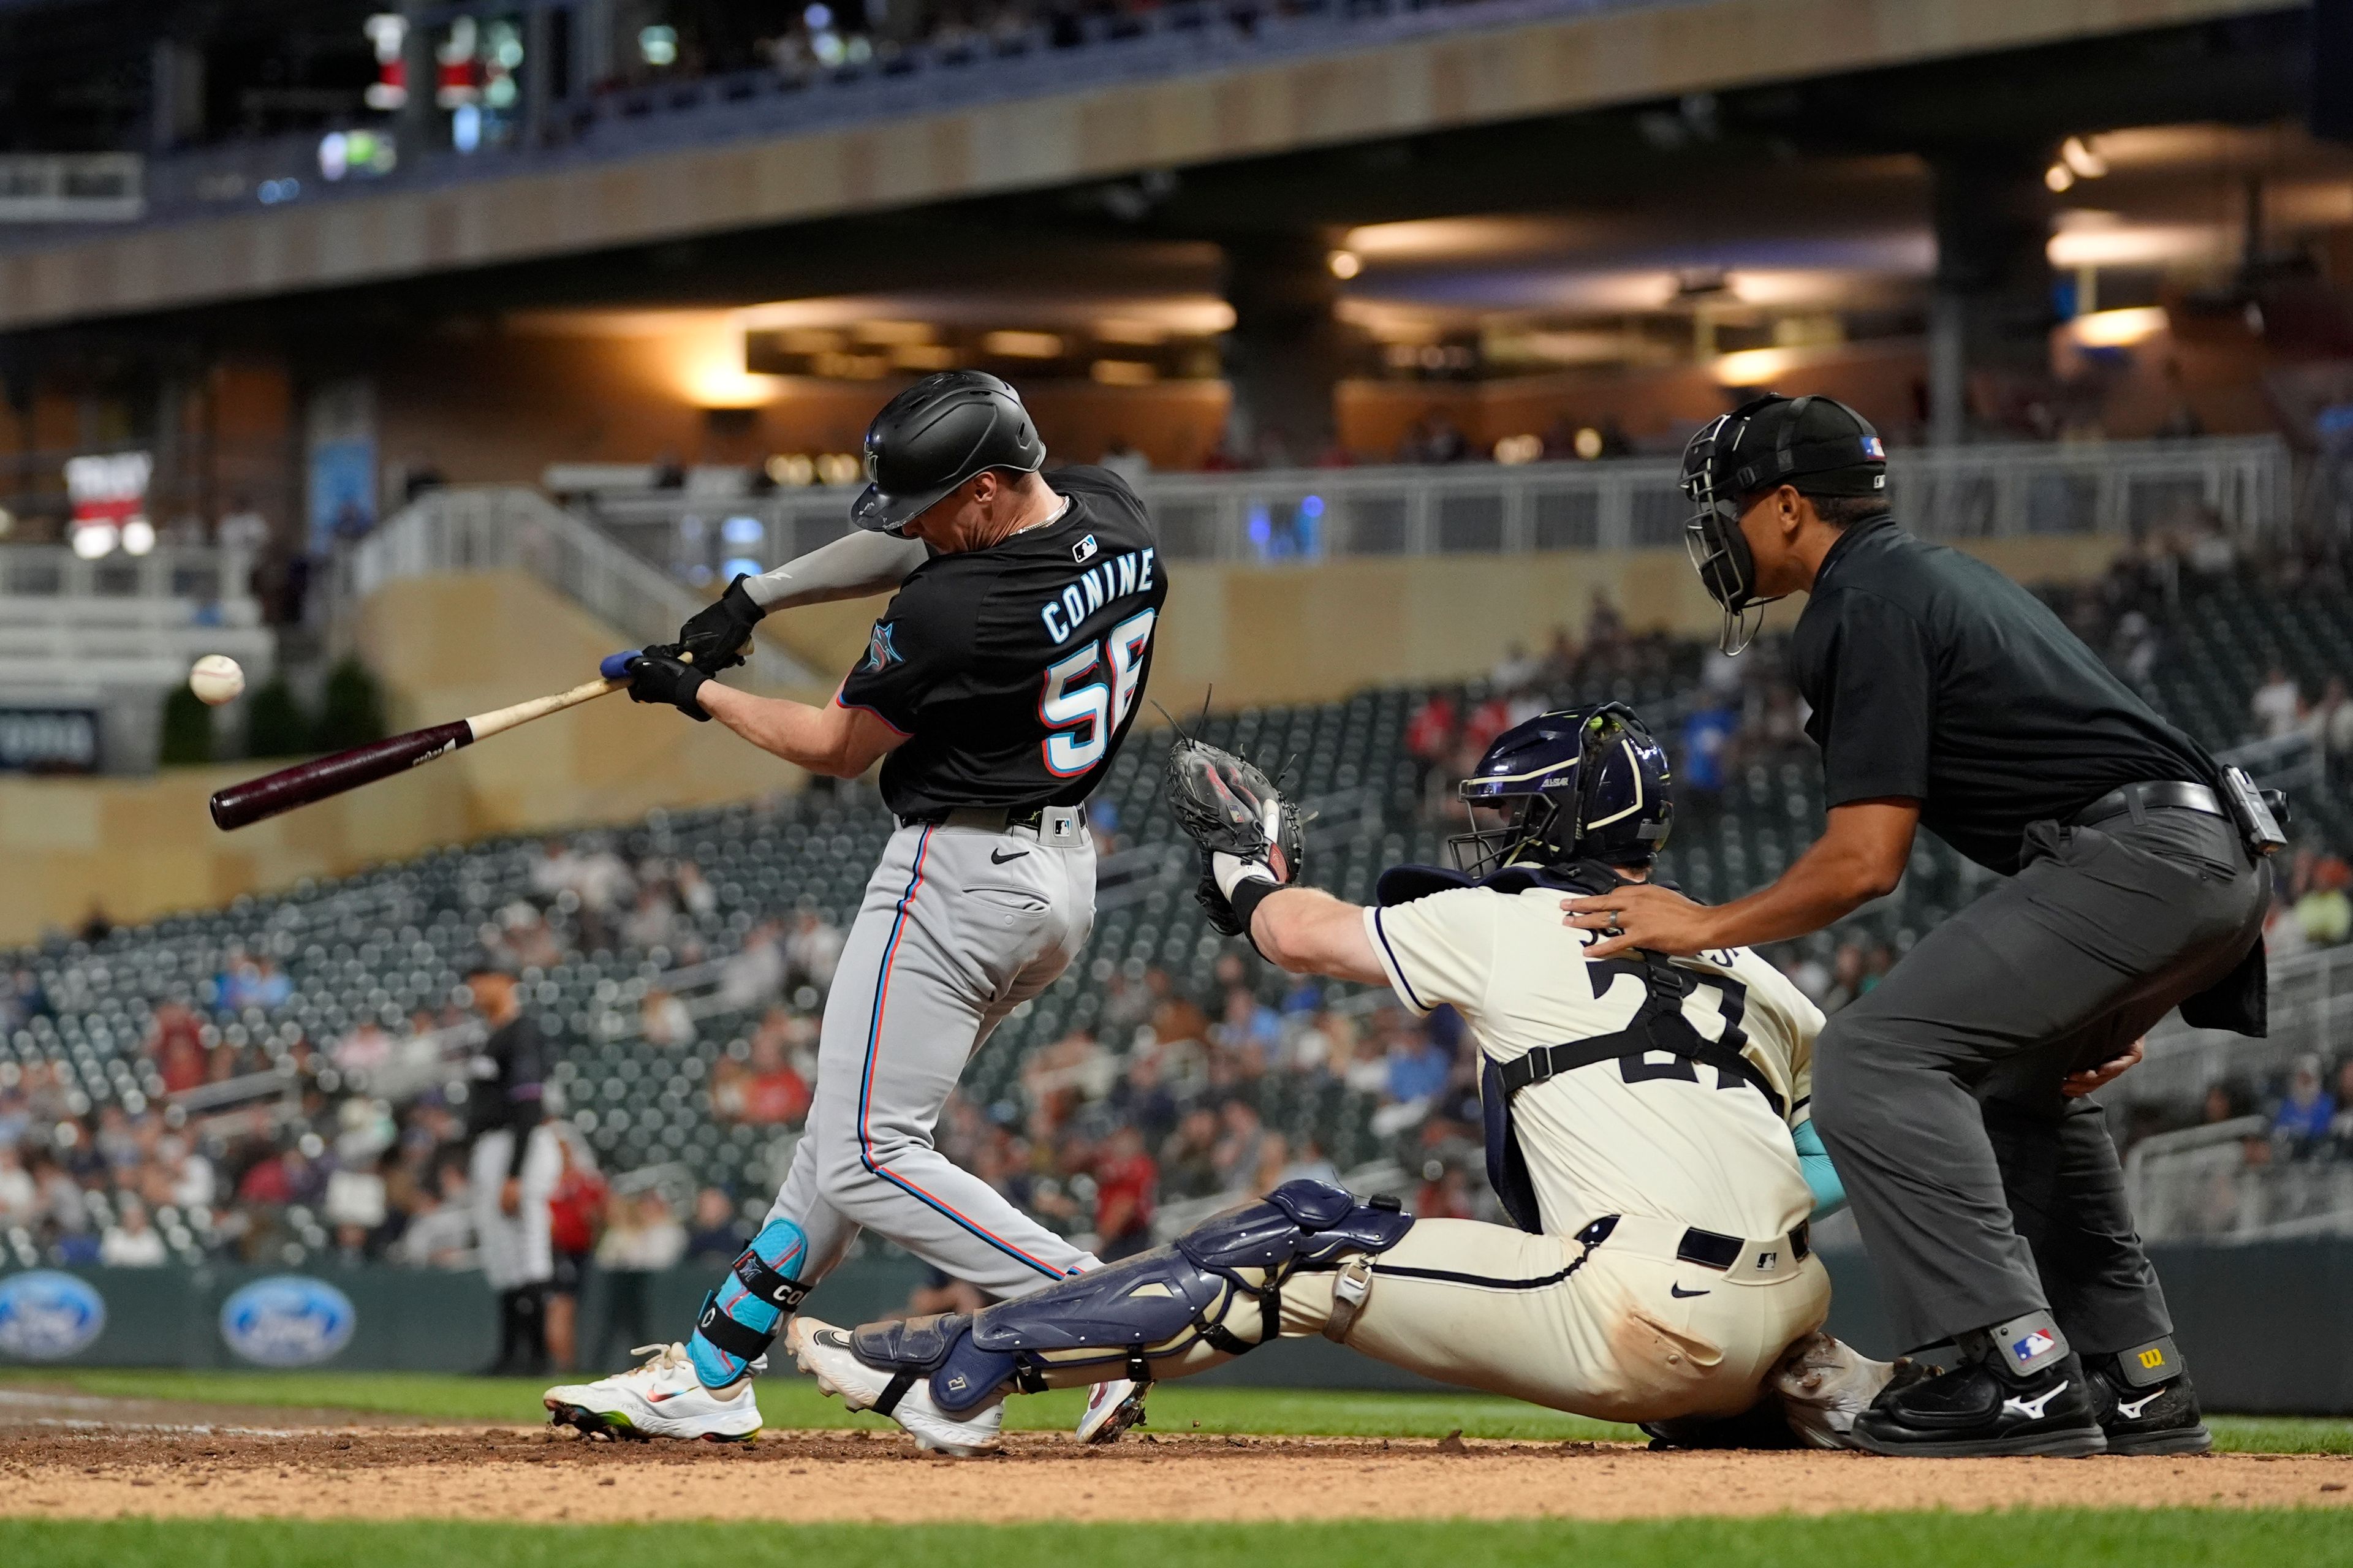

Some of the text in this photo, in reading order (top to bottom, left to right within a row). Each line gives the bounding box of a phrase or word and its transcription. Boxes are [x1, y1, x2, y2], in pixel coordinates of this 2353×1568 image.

[1041, 547, 1154, 644] CONINE
[1038, 607, 1156, 778] 56
[1585, 956, 1748, 1090] 27
[948, 1376, 967, 1391] 27
